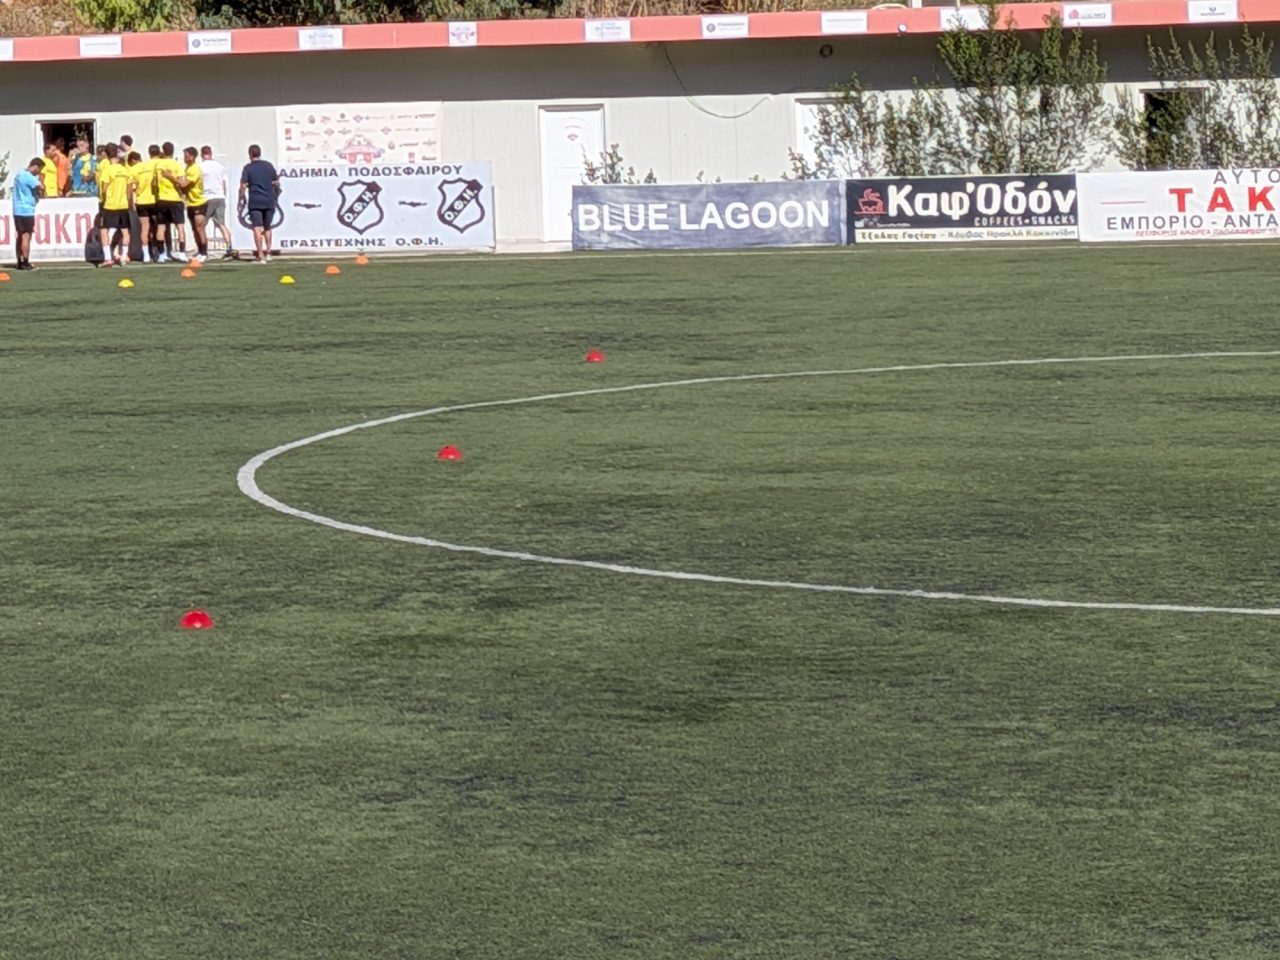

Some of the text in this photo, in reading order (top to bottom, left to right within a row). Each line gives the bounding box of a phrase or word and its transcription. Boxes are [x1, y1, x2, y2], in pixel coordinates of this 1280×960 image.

[278, 165, 463, 178] ΑΔΗΜΙΑ ΠΟΔΟΣΦΑΙΡΟΥ
[578, 200, 829, 231] BLUE LAGOON
[1107, 215, 1203, 230] ΕΜΠΟΡΙΟ
[280, 236, 443, 248] ΕΡΑΣΙΤΕΧΝΗΣ Ο.Φ.Η.
